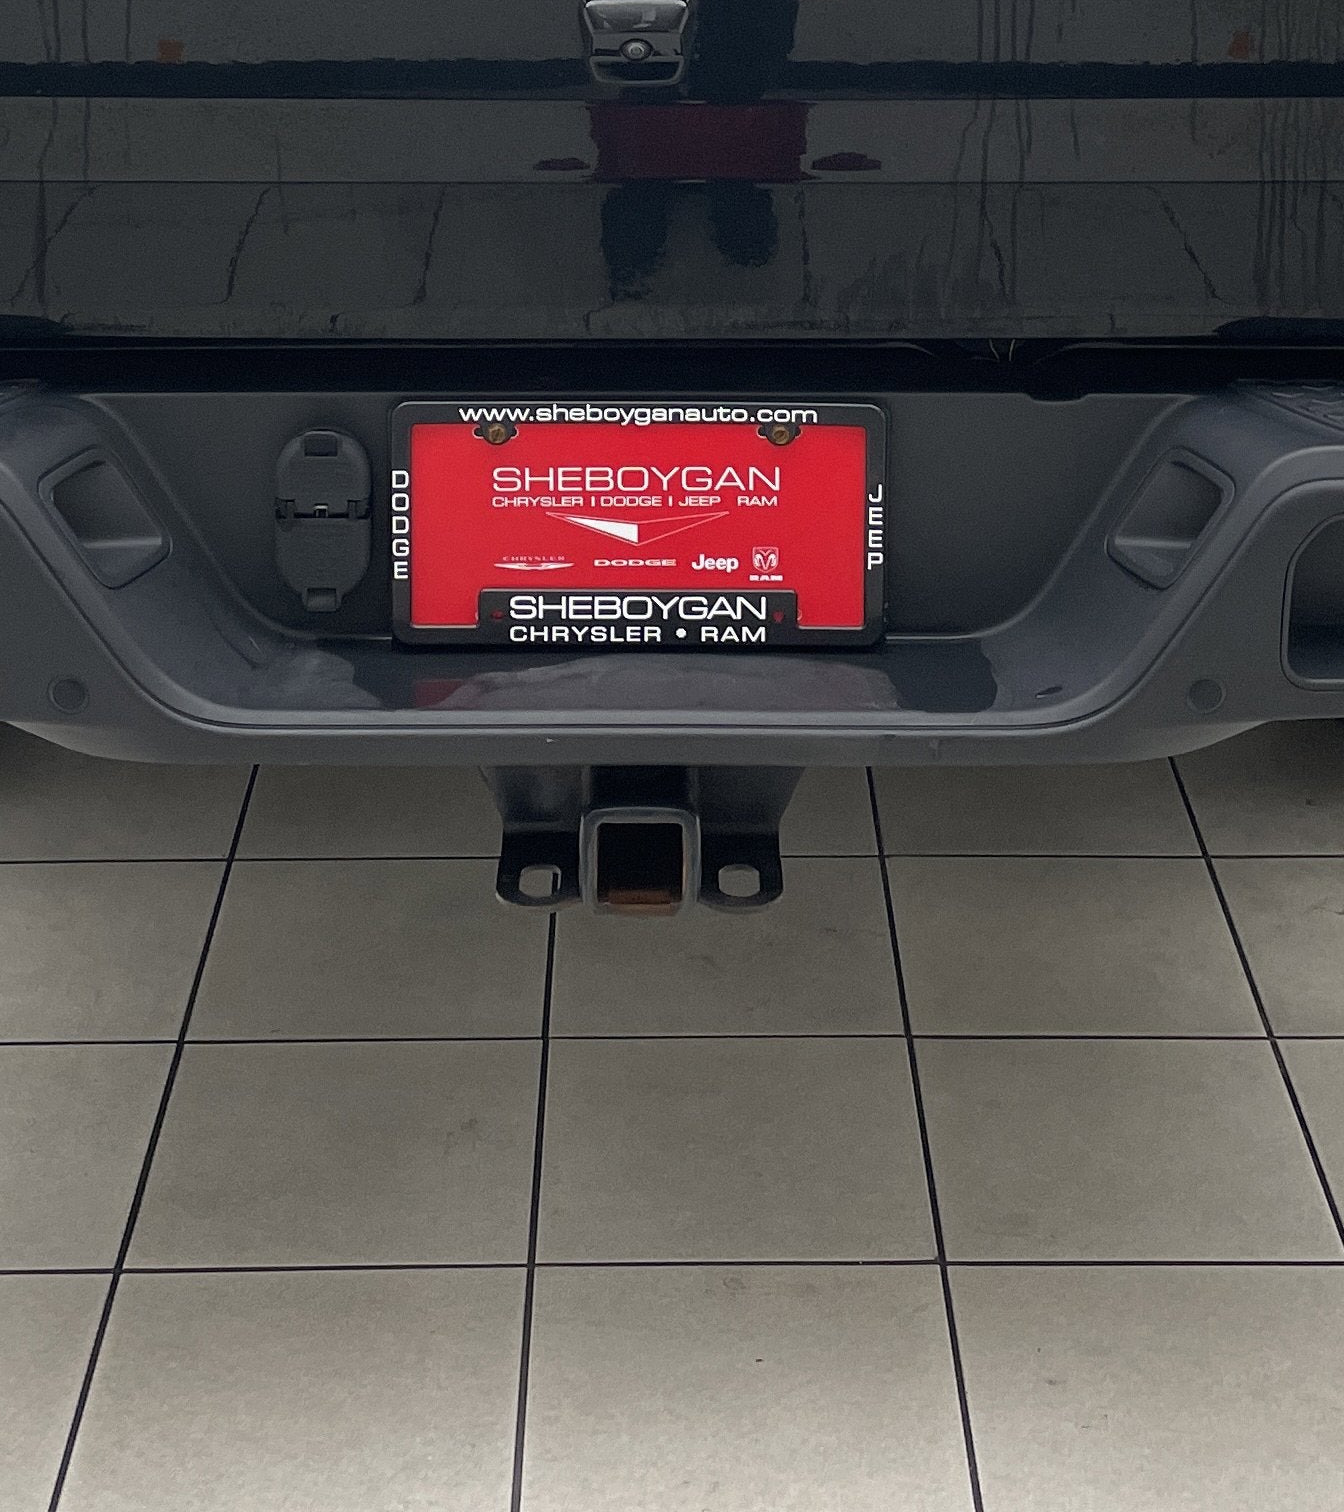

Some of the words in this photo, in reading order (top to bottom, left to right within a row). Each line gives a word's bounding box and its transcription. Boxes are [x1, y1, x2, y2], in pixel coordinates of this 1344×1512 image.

[458, 403, 818, 426] www.sheboyganauto.com
[492, 466, 781, 492] SHEBOYGAN
[492, 496, 584, 508] CHRYSLER
[600, 495, 662, 508] DODGE
[678, 495, 721, 507] JEEP
[737, 495, 778, 507] RAM
[391, 470, 410, 580] DODGE
[867, 484, 885, 571] JEEP
[593, 558, 677, 567] DODGE
[691, 554, 739, 574] Jeep
[749, 574, 784, 582] RAM
[509, 595, 768, 621] SHEBOYGAN
[509, 625, 662, 643] CHRYSLER
[701, 625, 767, 643] RAM
